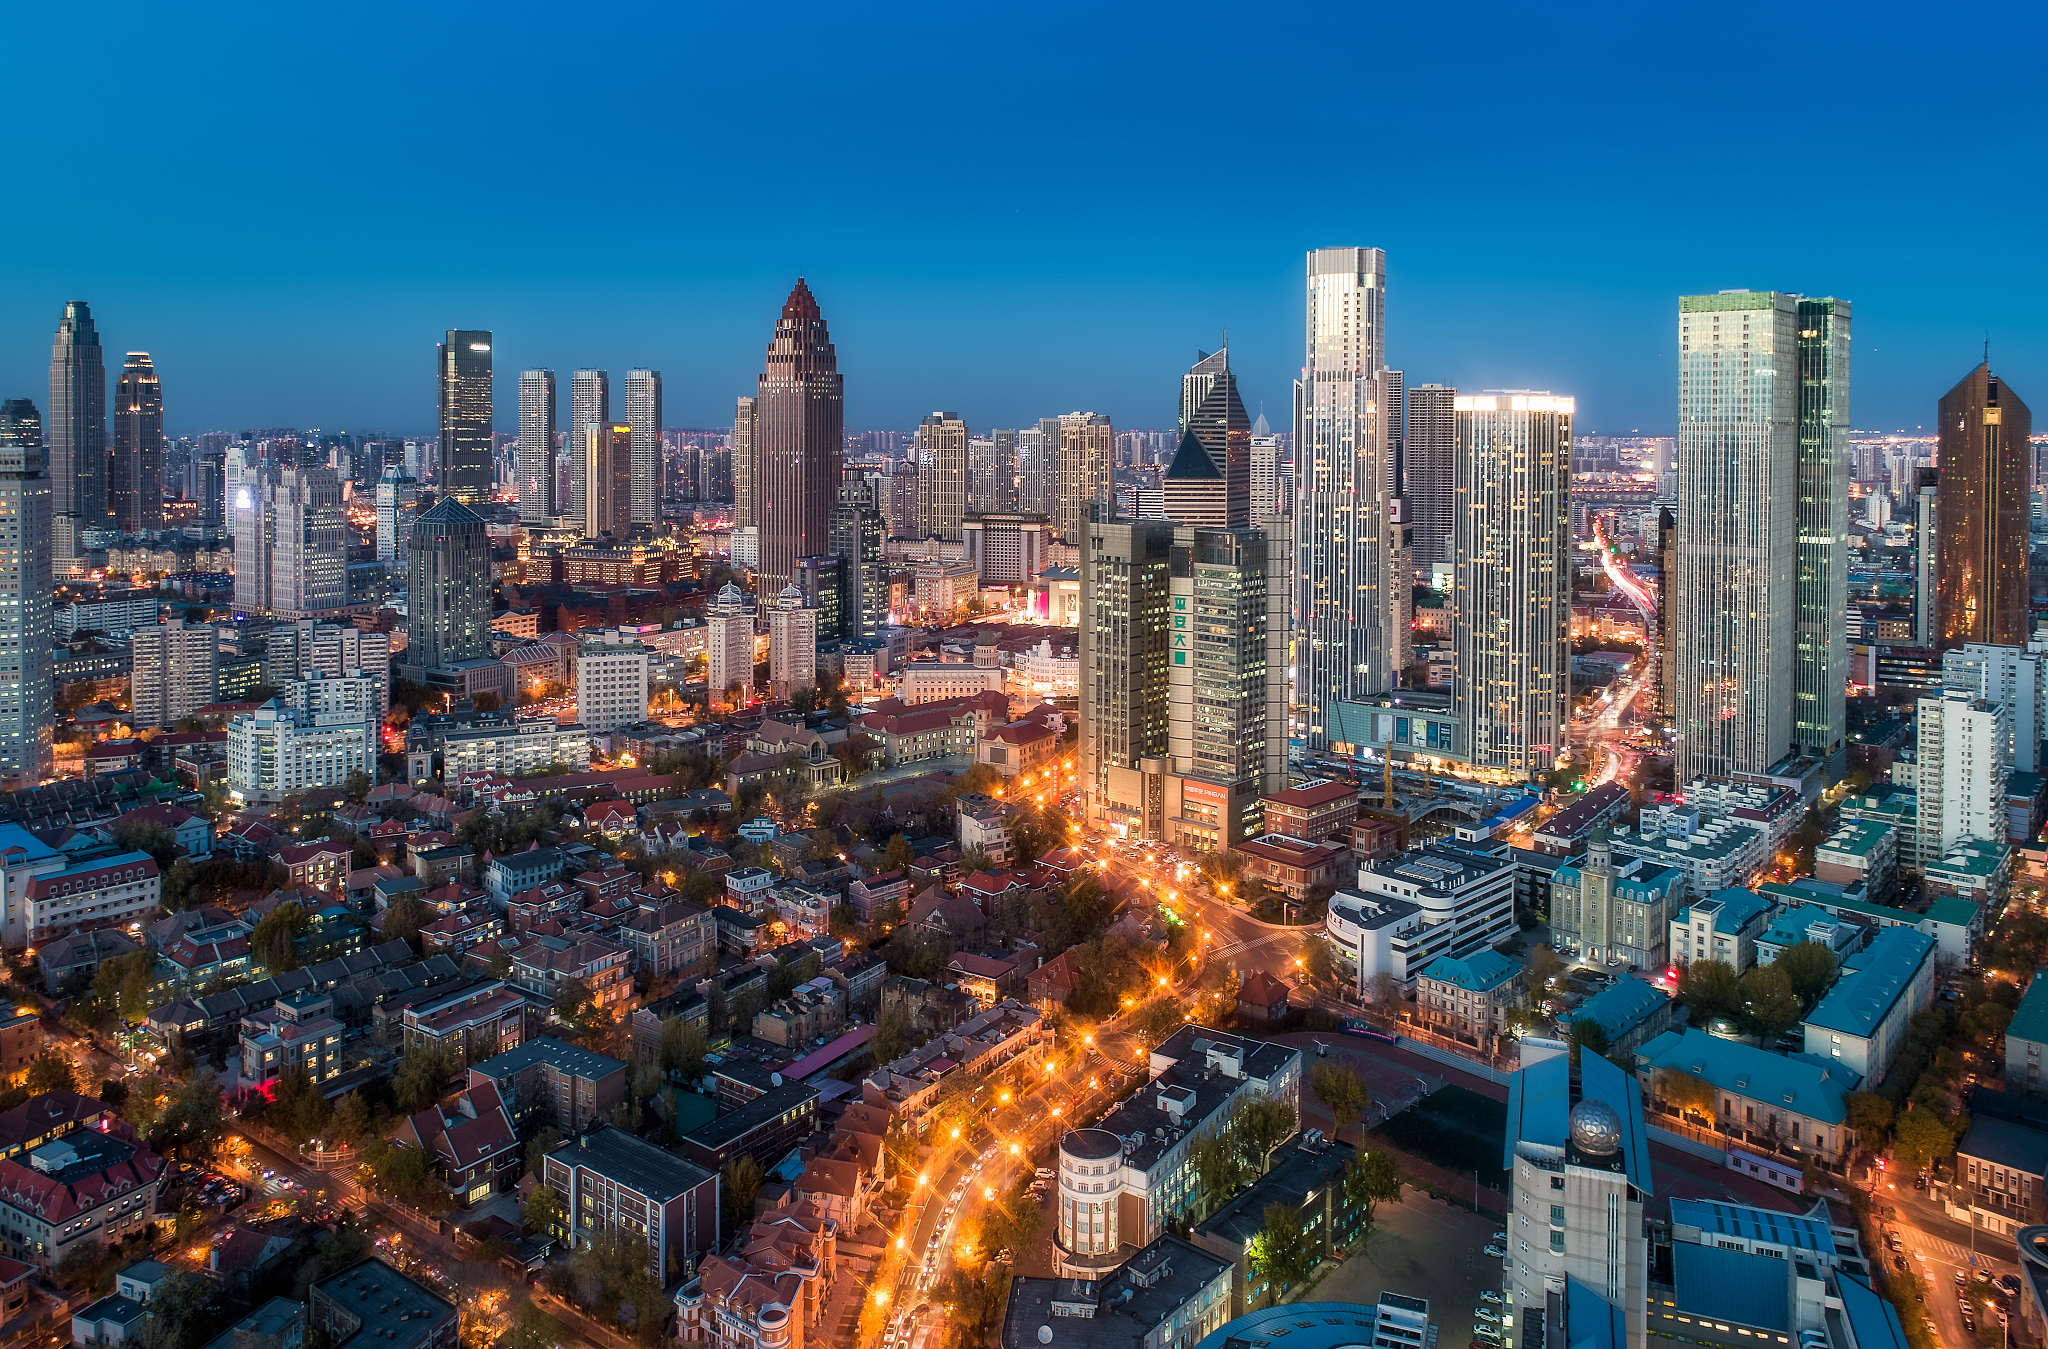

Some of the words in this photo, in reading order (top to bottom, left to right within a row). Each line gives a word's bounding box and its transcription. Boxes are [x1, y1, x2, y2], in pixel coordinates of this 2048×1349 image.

[795, 559, 808, 567] Bank
[1892, 646, 1943, 658] SINOP
[1204, 789, 1226, 799] PINGAN
